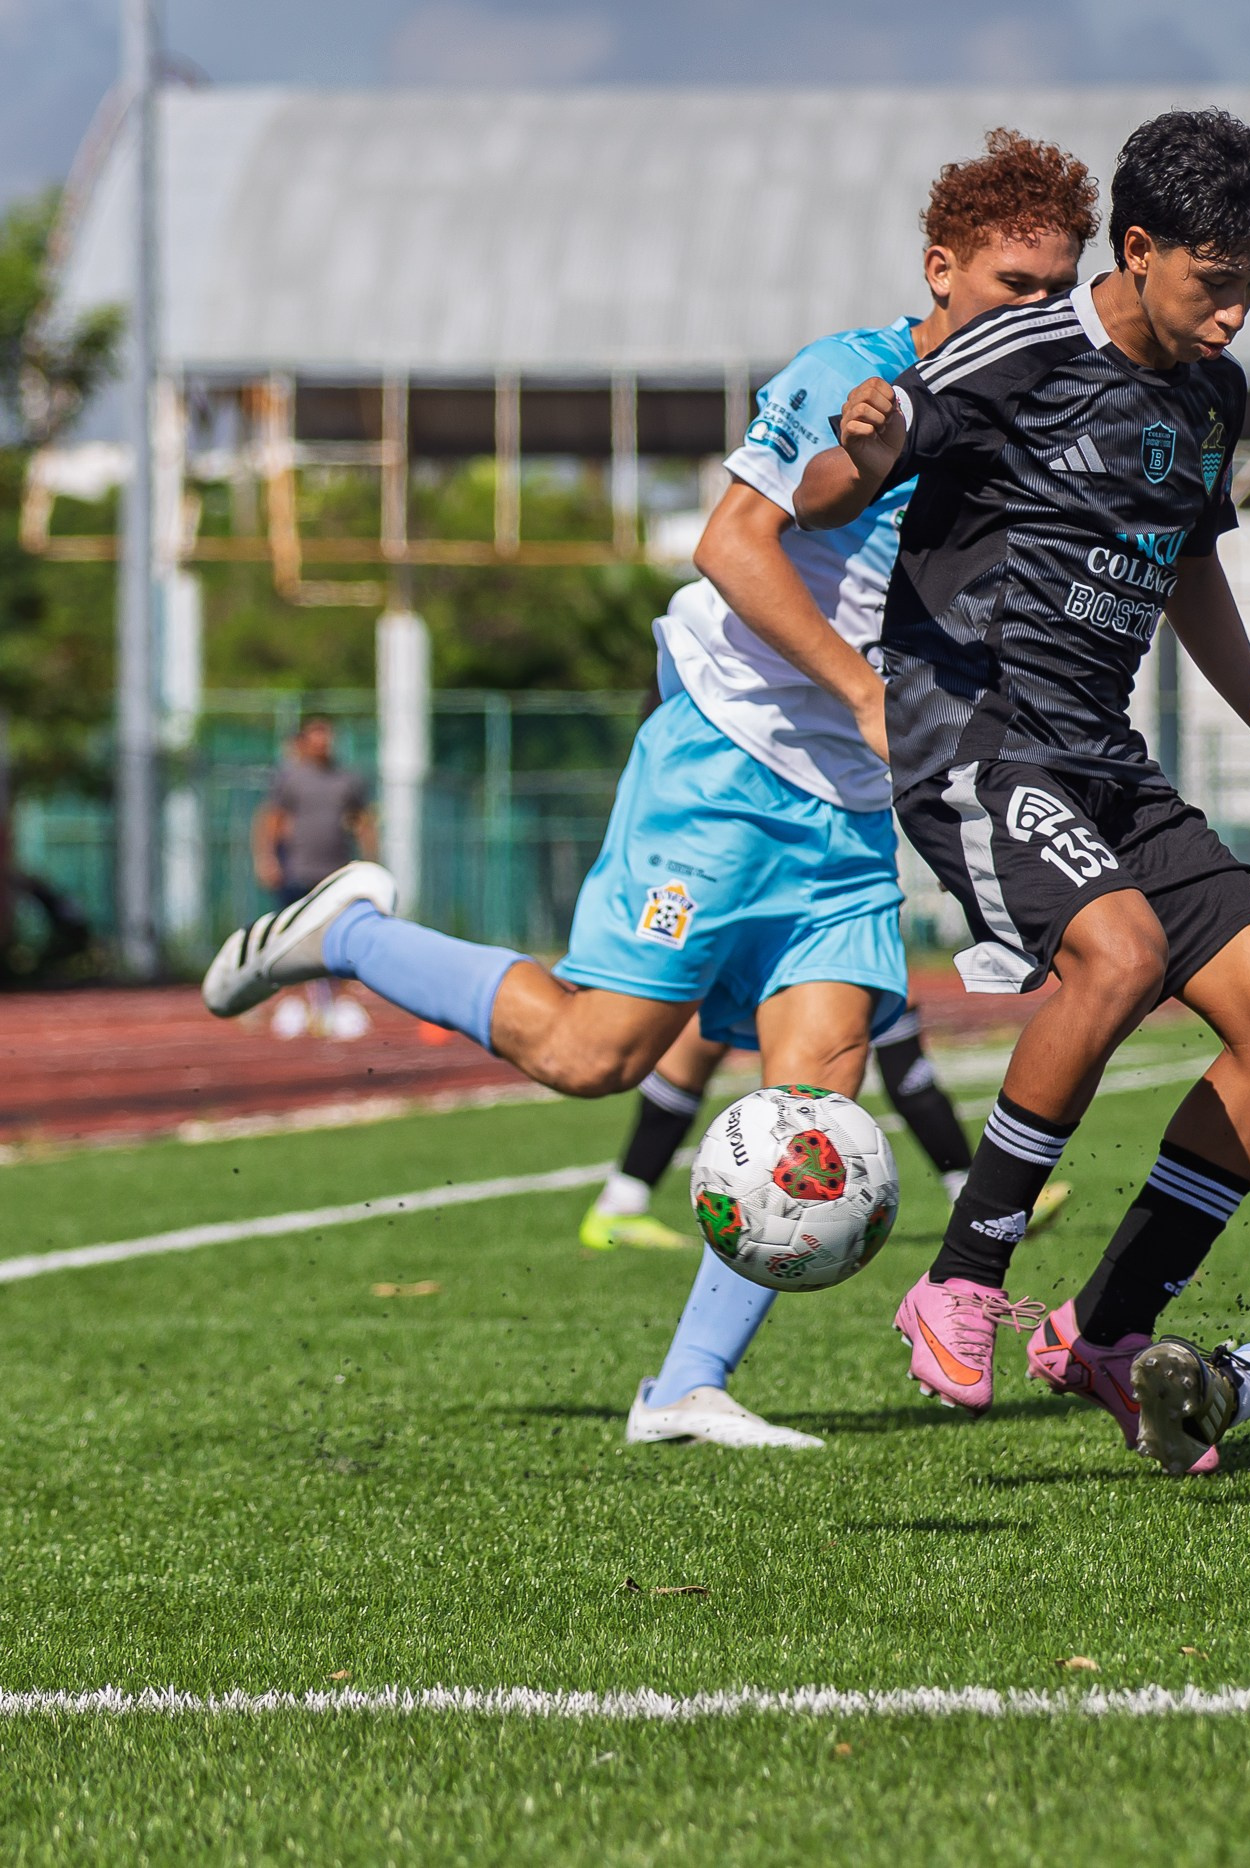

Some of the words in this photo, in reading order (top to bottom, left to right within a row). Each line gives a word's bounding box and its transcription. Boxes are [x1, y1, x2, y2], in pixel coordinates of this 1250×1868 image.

[1150, 449, 1164, 470] B
[1040, 827, 1119, 888] 135
[726, 1104, 750, 1167] molten
